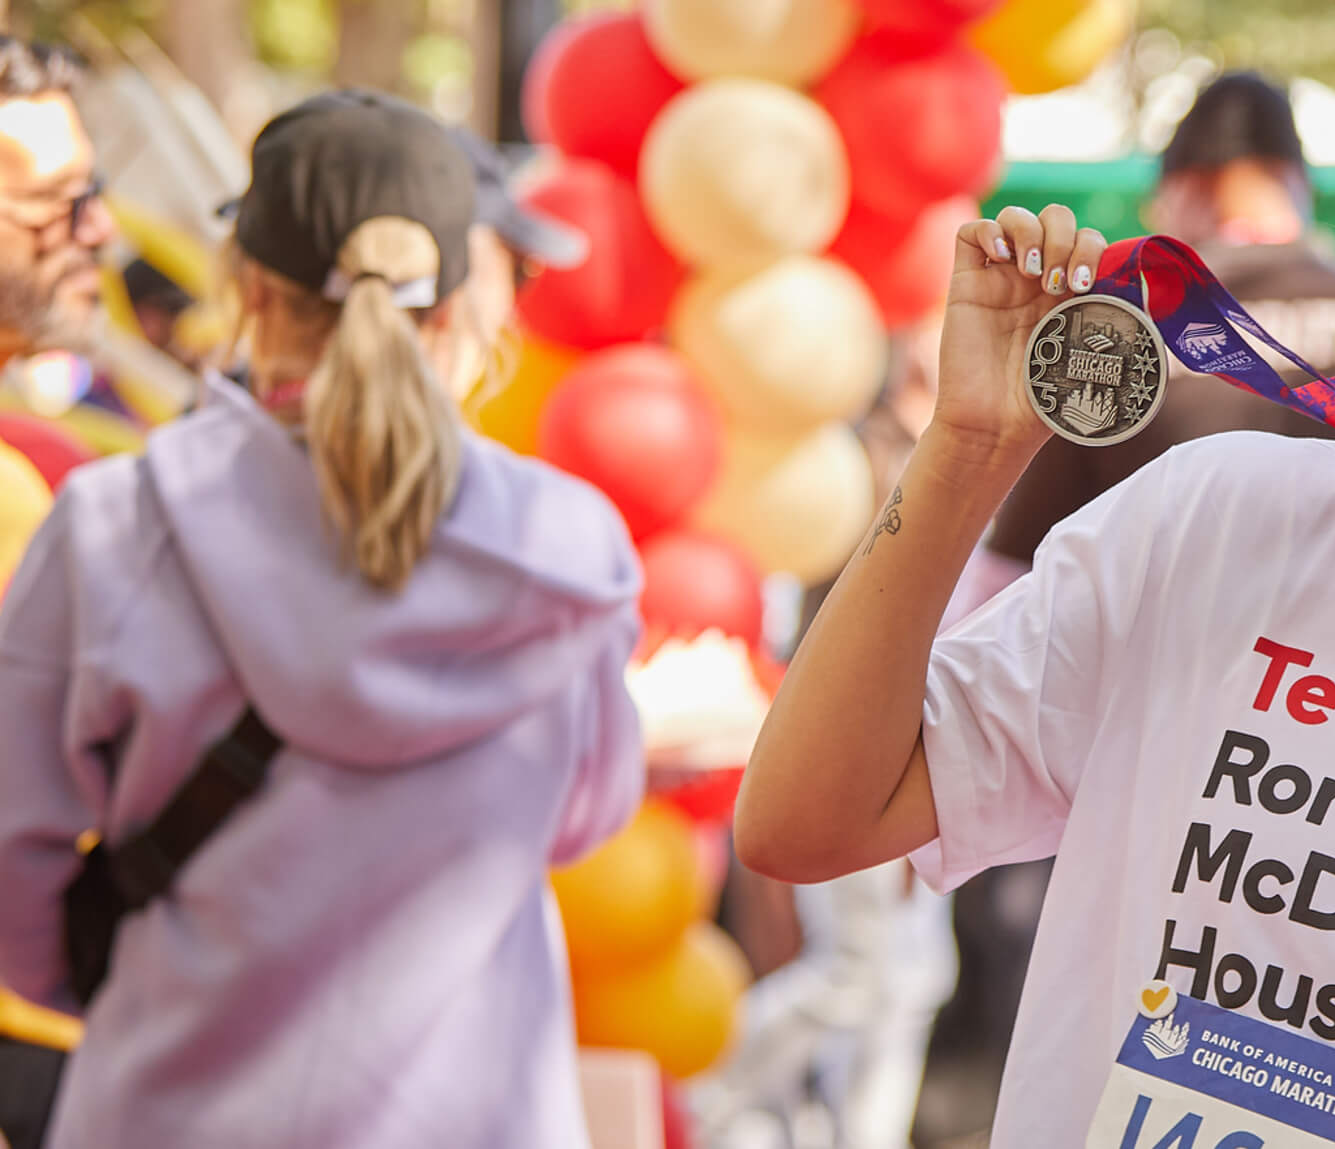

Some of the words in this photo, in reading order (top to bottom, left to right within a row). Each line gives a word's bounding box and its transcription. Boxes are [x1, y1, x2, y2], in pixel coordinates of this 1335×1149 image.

[1066, 367, 1122, 387] MARATHON
[1068, 356, 1122, 376] CHICAGO
[1191, 1048, 1269, 1088] CHICAGO
[1201, 1030, 1241, 1052] BANK
[1242, 1044, 1264, 1060] OF
[1263, 1053, 1333, 1087] AMERICA
